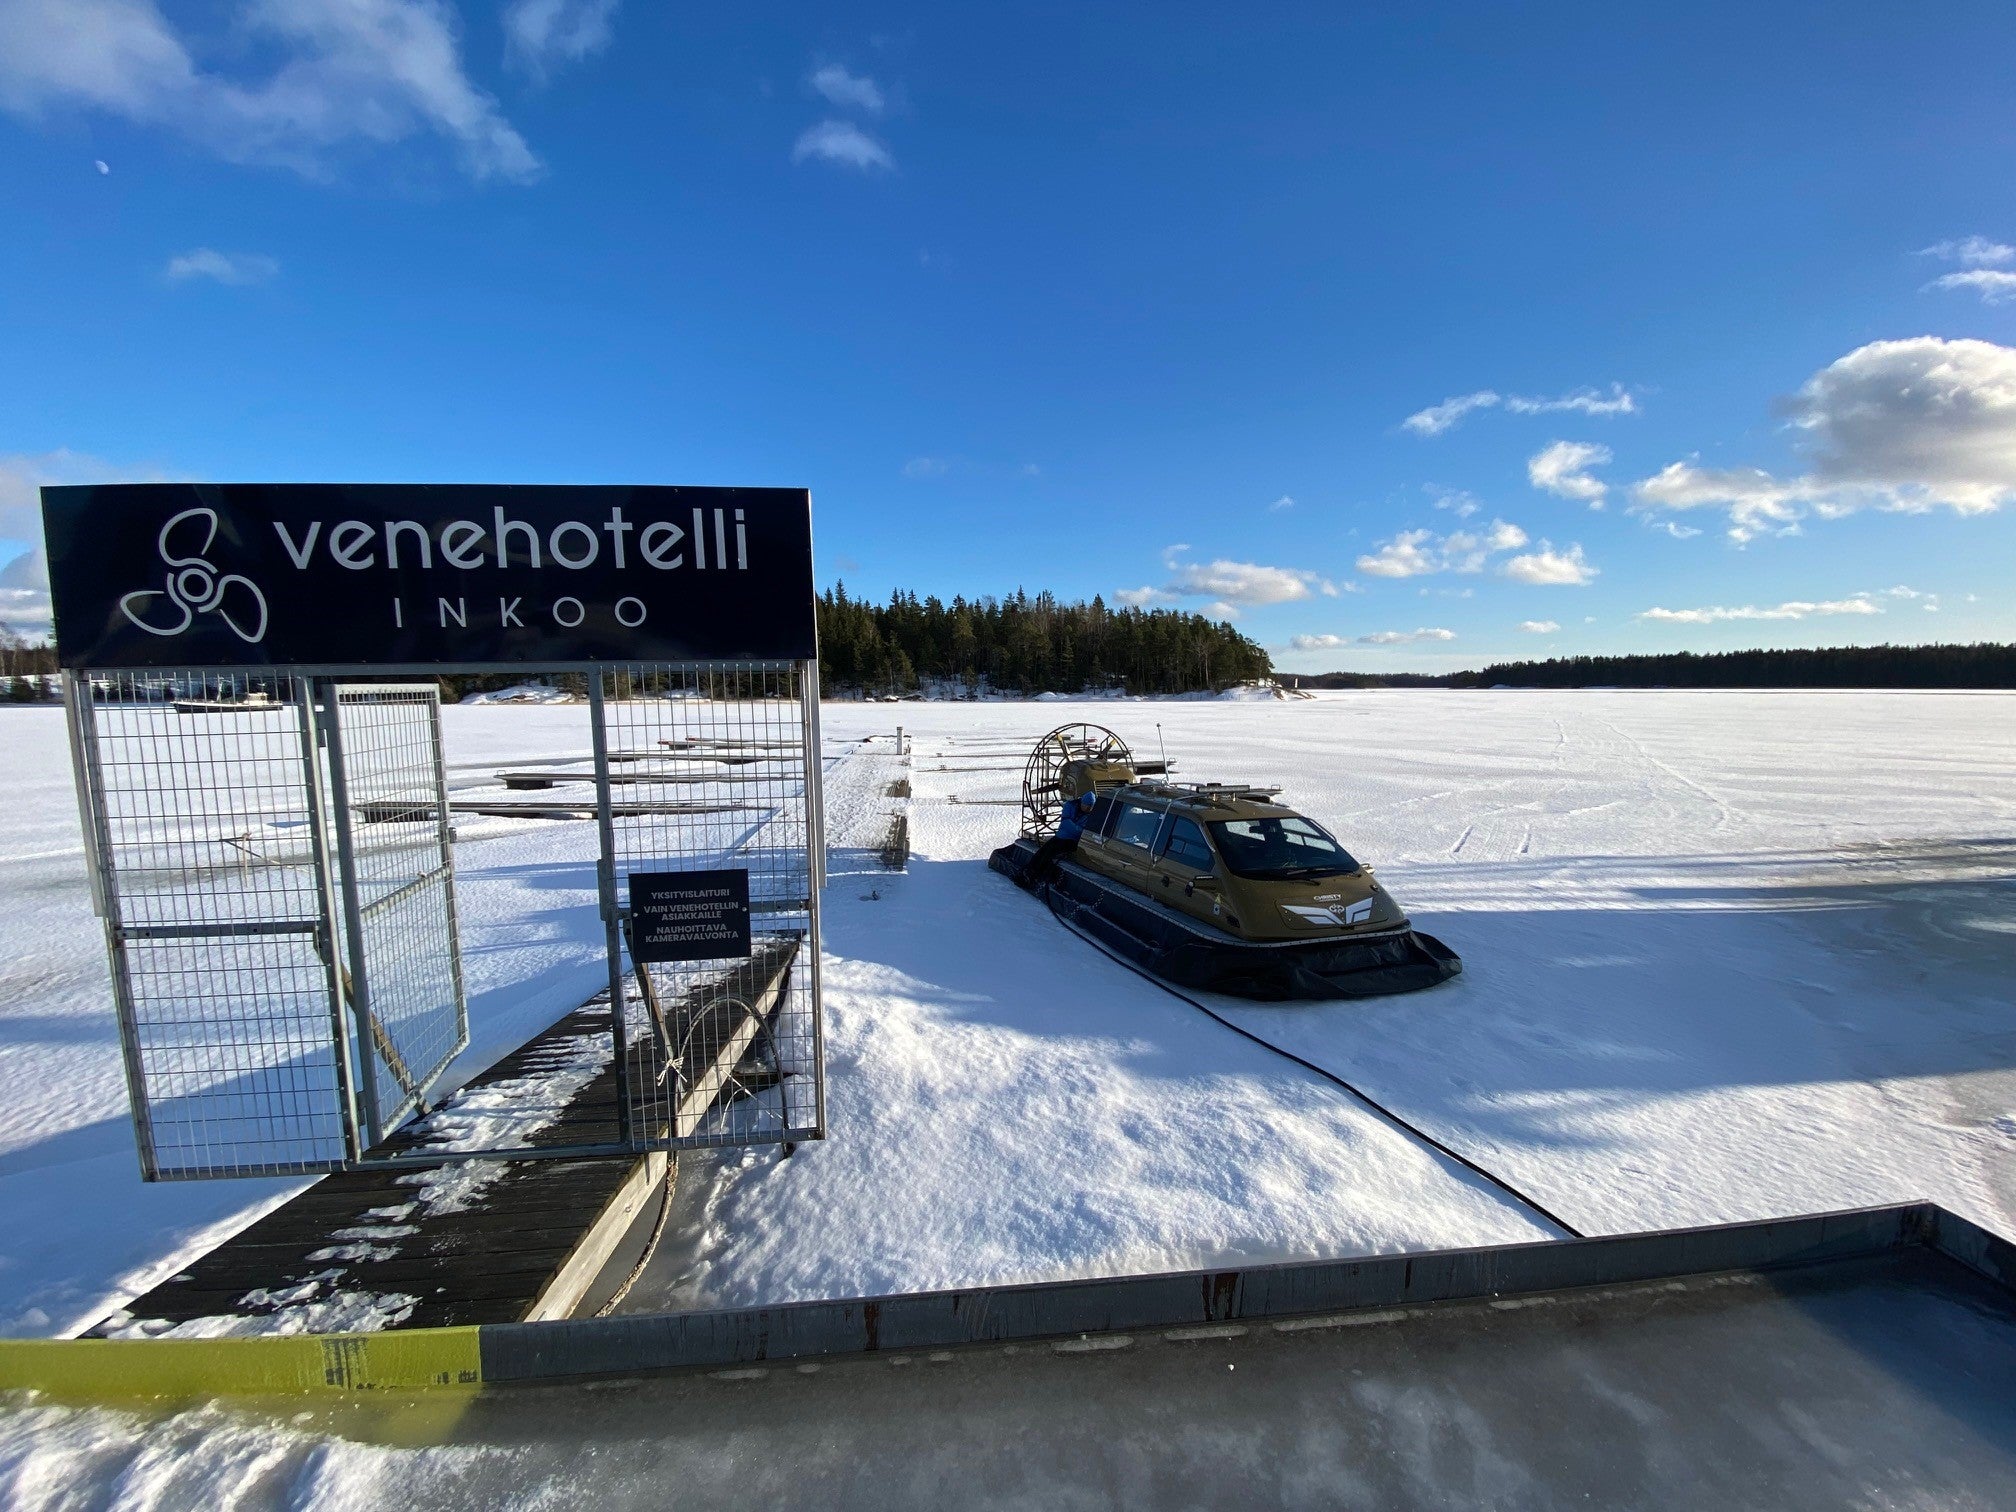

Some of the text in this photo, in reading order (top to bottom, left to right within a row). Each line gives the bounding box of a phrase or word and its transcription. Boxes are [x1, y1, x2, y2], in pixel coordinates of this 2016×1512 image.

[273, 506, 748, 570] venehotelli
[395, 597, 647, 628] INKOO
[651, 889, 730, 899] YKSITYISLAITURI
[644, 902, 739, 914] VAIN VENEHOTELLIN
[661, 911, 722, 921] ASIAKKAILLE
[656, 924, 727, 934] NAUHOITTAVA
[645, 931, 739, 943] KAMERAVALVONTA
